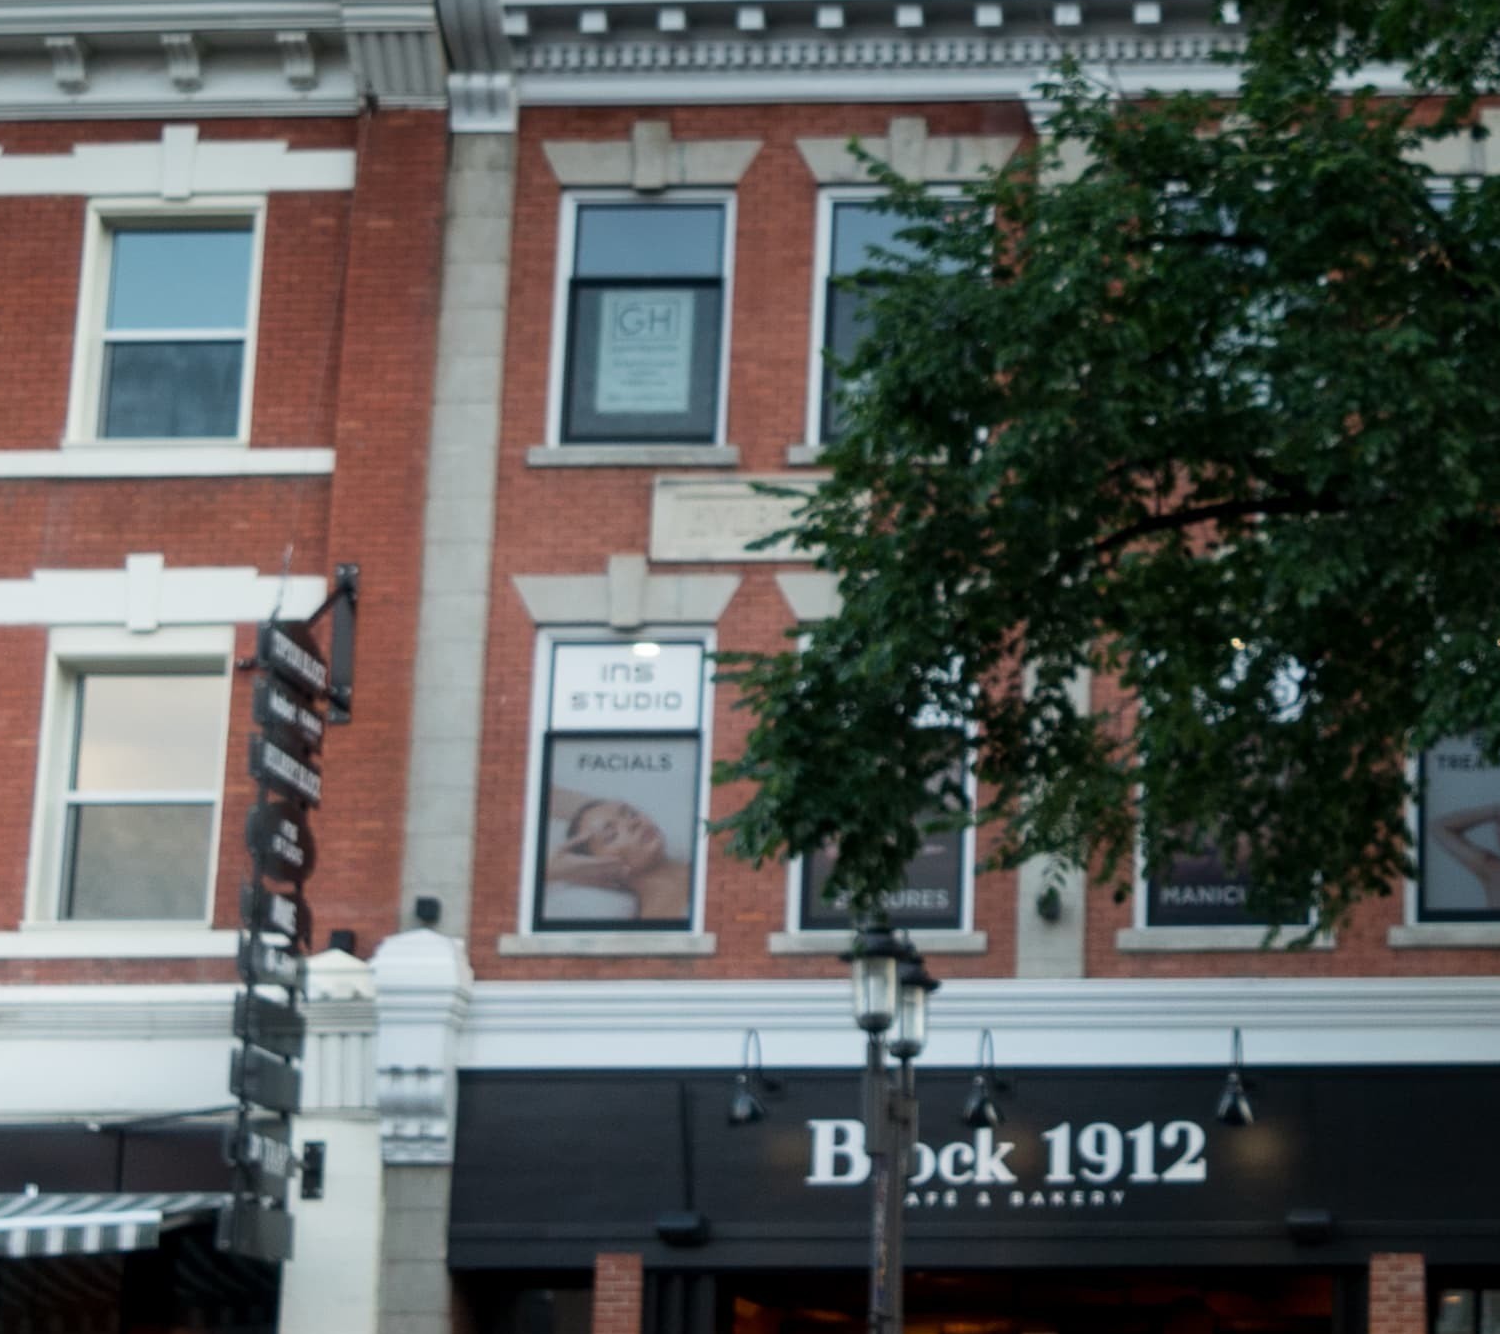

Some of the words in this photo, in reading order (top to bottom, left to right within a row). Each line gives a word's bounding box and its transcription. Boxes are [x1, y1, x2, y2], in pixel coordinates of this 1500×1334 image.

[570, 691, 682, 711] STUDIO
[578, 753, 673, 773] FACIALS
[804, 1118, 1018, 1186] Bock
[1042, 1120, 1208, 1183] 1912
[902, 1186, 958, 1208] AFÉ
[977, 1191, 992, 1207] &
[1010, 1190, 1126, 1208] BAKERY
